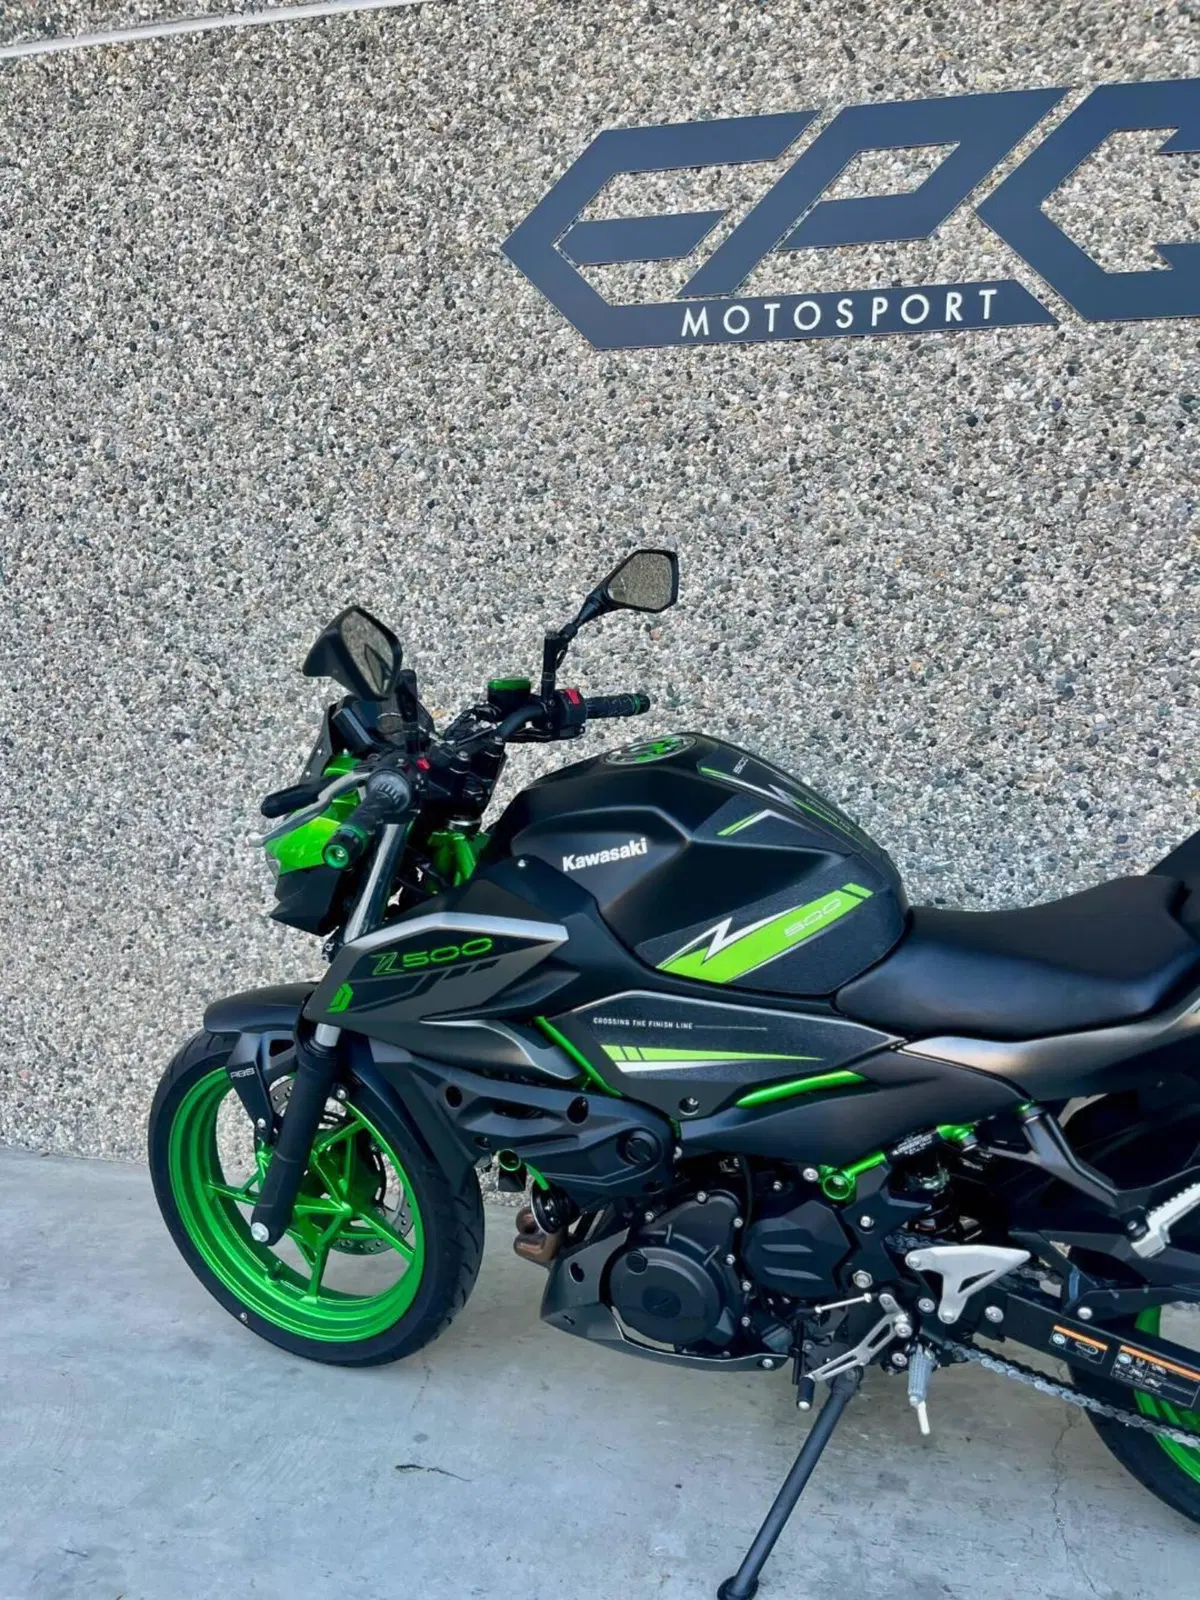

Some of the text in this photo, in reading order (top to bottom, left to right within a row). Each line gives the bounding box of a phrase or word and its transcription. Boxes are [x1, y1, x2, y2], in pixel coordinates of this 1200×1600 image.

[680, 287, 999, 338] MOTOSPORT
[562, 837, 648, 872] Kawasaki
[784, 898, 842, 937] 500
[593, 1017, 694, 1030] CROSSING THE FINISH LINE
